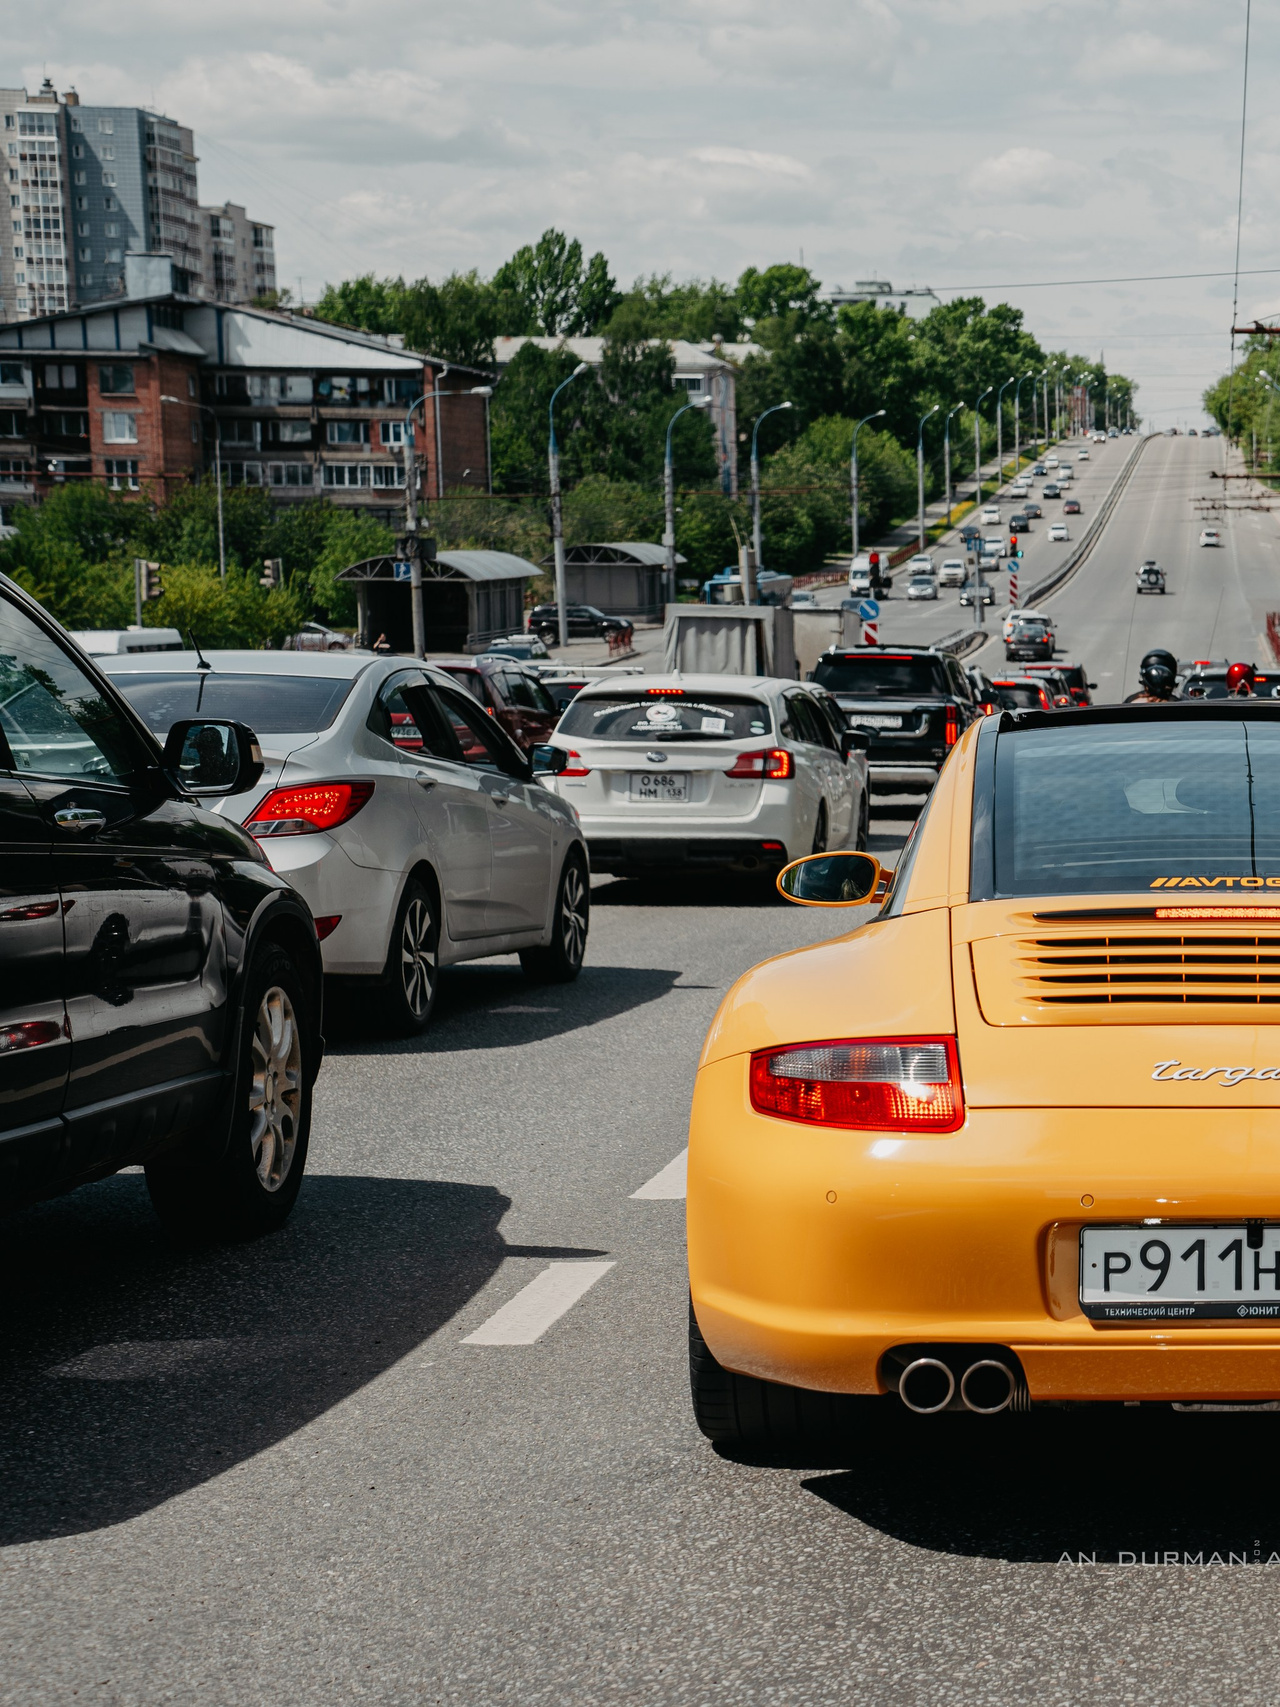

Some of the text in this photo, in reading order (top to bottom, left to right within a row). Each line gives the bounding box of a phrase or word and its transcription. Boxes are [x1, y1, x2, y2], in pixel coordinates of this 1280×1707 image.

[653, 775, 675, 786] 686
[665, 788, 682, 797] 138
[1104, 1306, 1165, 1316] ТЕХНИЧЕСКИЙ
[1167, 1307, 1195, 1316] ЦЕНТР
[1249, 1306, 1279, 1315] ЮНИТ
